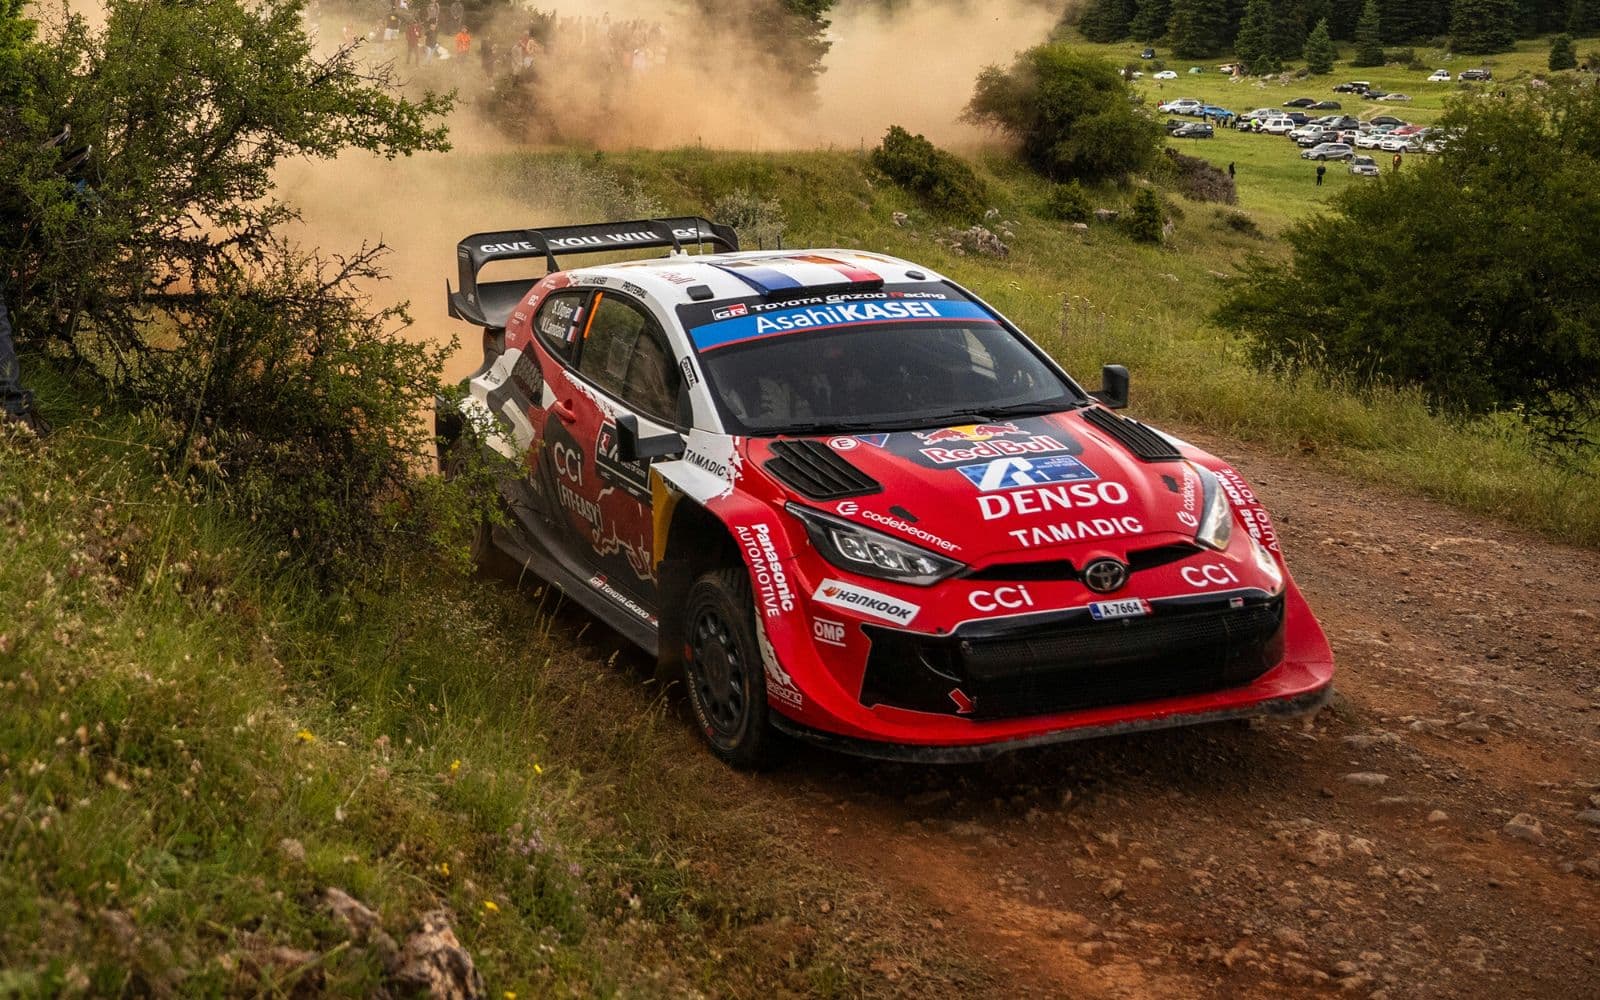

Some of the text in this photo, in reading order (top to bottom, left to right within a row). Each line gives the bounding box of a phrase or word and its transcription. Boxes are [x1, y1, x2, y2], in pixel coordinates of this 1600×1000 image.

[480, 241, 536, 253] GIVE
[550, 234, 602, 247] YOU
[713, 290, 946, 320] GR TOYOTA GAZOO Racing
[757, 302, 941, 333] AsahiKASEI
[686, 449, 727, 476] TAMADIC
[920, 435, 1069, 463] Red Bull
[976, 481, 1129, 521] DENSO
[862, 509, 956, 552] codebeamer
[1008, 516, 1144, 547] TAMADIC
[735, 526, 781, 618] AUTOMOTIVE
[751, 523, 794, 612] Panasonic
[1180, 563, 1240, 587] CCi
[967, 584, 1034, 611] CCi
[813, 621, 845, 641] OMP
